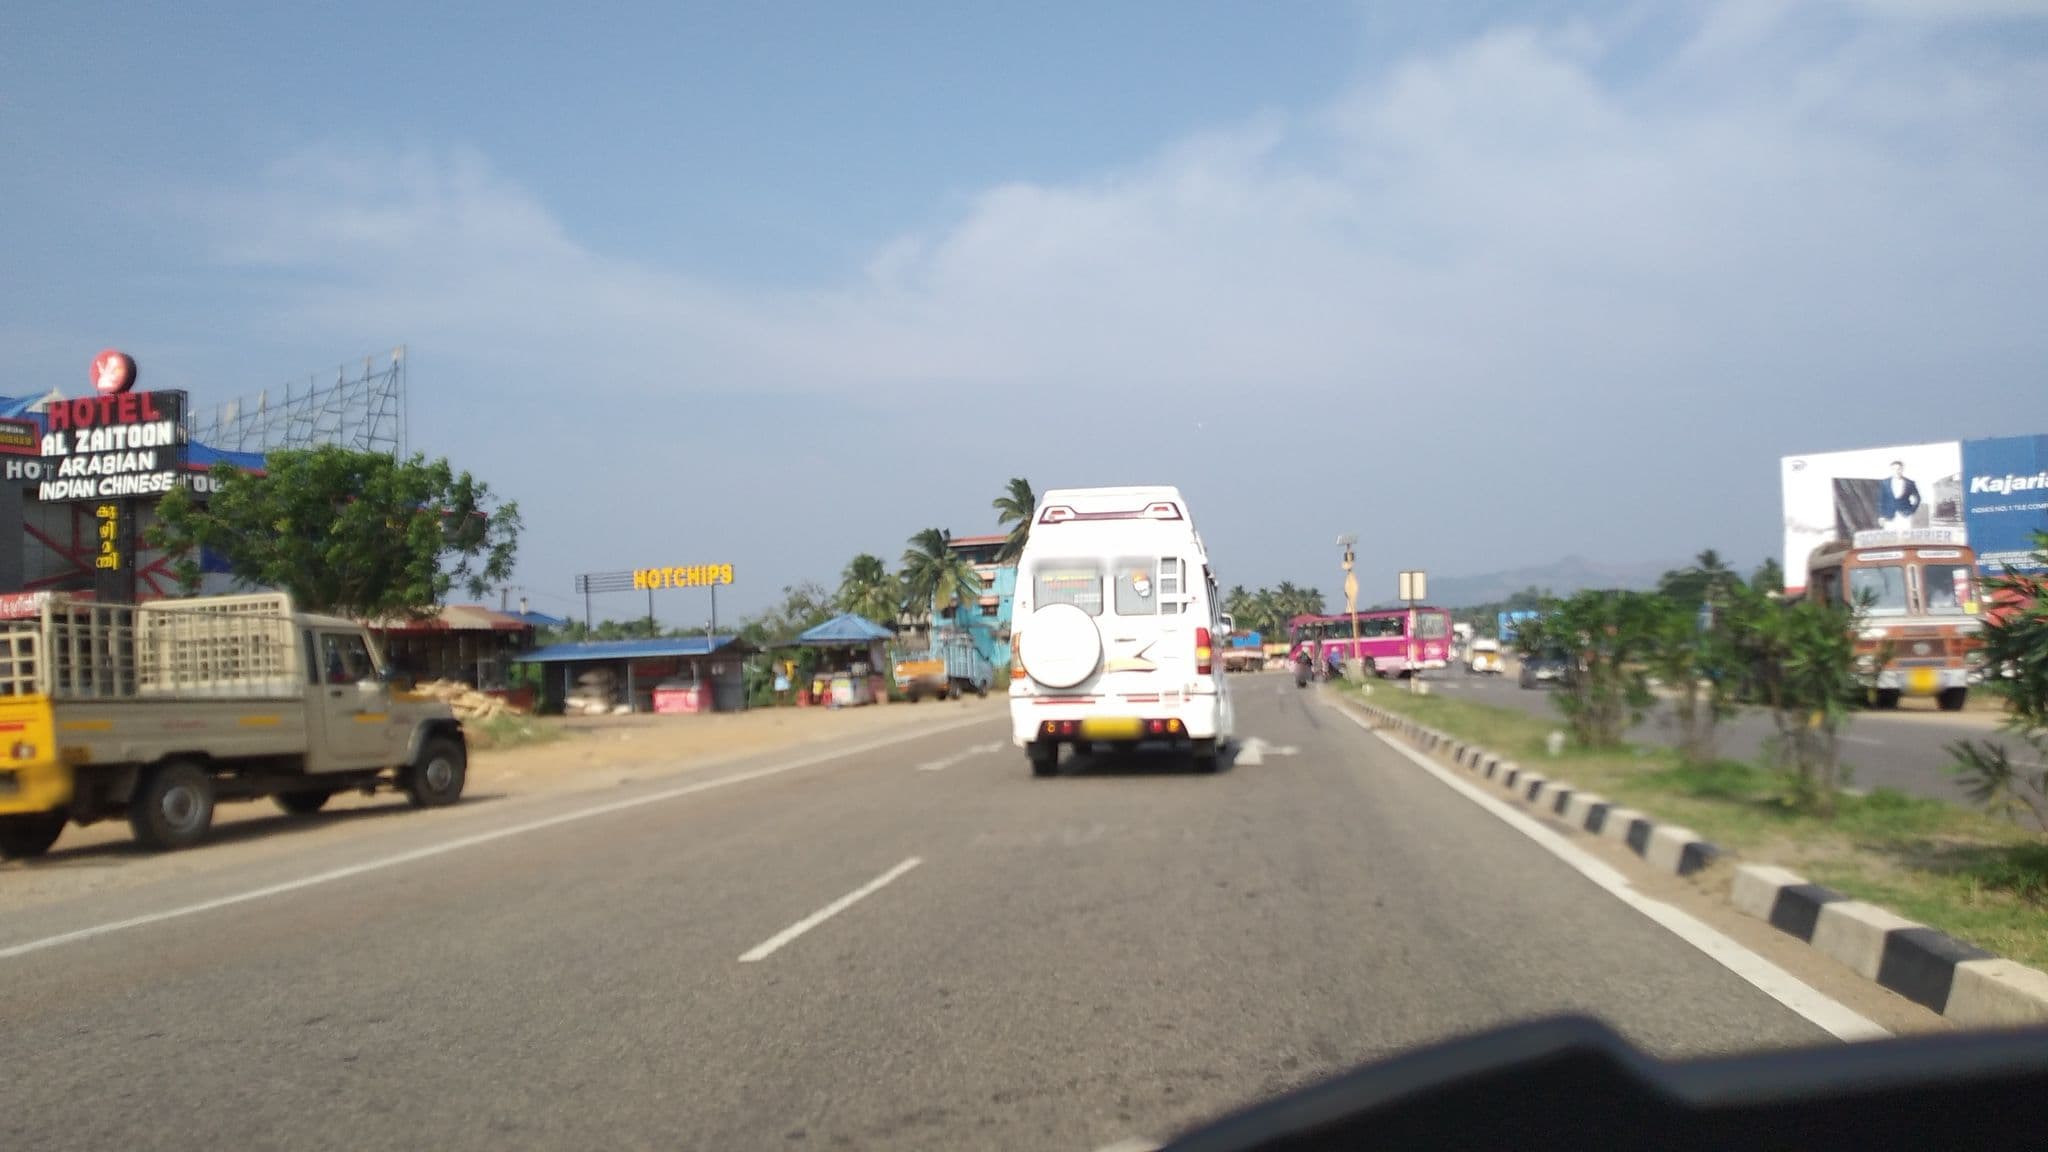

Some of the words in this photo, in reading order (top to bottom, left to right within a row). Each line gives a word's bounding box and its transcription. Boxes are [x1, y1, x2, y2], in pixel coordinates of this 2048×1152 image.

[49, 392, 160, 430] HOTEL
[41, 432, 68, 457] AL
[75, 421, 174, 453] ZAITOON
[58, 451, 156, 477] ARABIAN
[39, 478, 97, 500] INDIAN
[99, 472, 175, 496] CHINESE
[1970, 471, 2048, 495] Kajari
